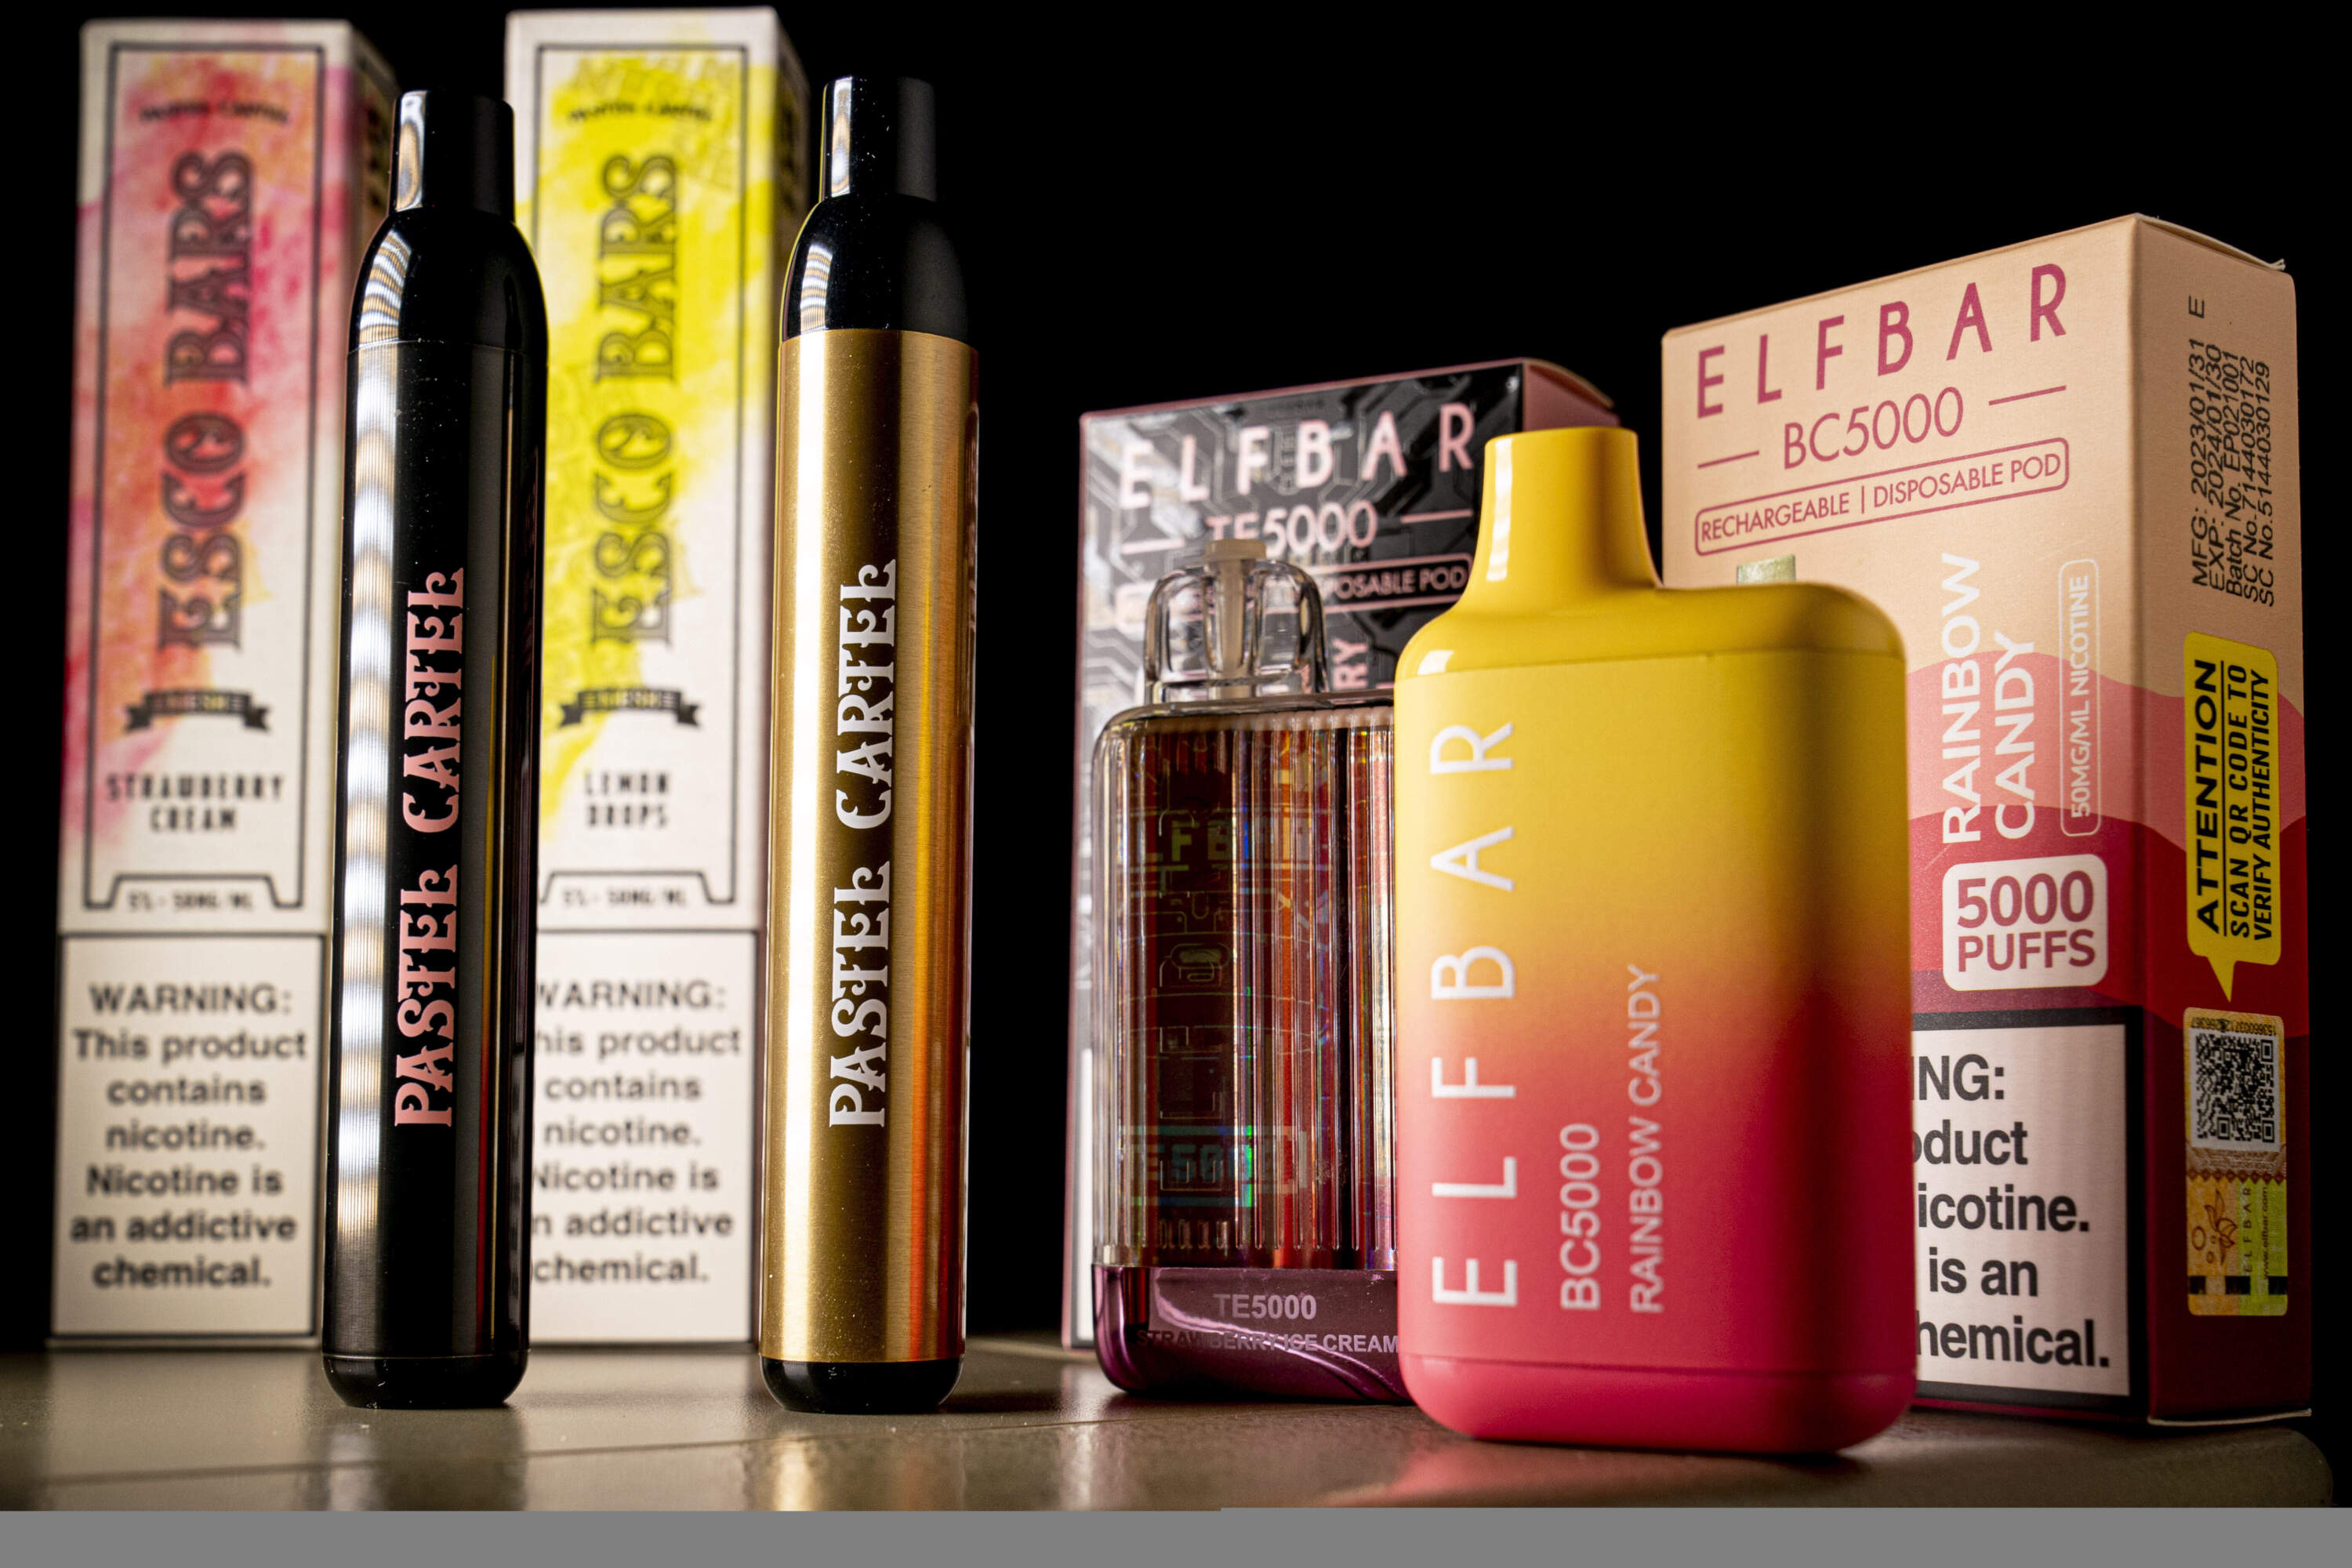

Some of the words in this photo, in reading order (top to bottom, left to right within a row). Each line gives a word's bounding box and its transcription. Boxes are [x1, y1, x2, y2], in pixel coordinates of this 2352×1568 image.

[165, 150, 252, 387] BARS
[594, 152, 680, 386] BARS
[1697, 263, 2067, 419] ELFBAR
[2188, 295, 2205, 318] E
[1783, 387, 1964, 470] BC5000
[2188, 339, 2207, 496] 2023/01/31
[2205, 343, 2224, 510] 2024/01/30
[2222, 350, 2241, 473] EP021001
[1119, 402, 1475, 510] ELFBAR
[1700, 492, 1849, 543] RECHARGEABLE
[1873, 462, 2003, 509] DISPOSABLE
[2010, 452, 2062, 482] POD
[2224, 481, 2241, 521] No.
[2190, 506, 2208, 586] MFG:
[2209, 518, 2225, 591] EXP:
[2225, 528, 2243, 597] Batch
[2244, 564, 2259, 602] SC
[2259, 568, 2274, 607] SC
[2069, 574, 2090, 696] NICOTINE
[403, 566, 465, 833] CARTEL
[836, 559, 897, 829] CARTEL
[1942, 553, 1981, 845] RAINBOW
[2227, 664, 2248, 700] TO
[1994, 630, 2035, 839] CANDY
[2070, 699, 2091, 819] 50MG/ML
[2228, 713, 2248, 792] CODE
[2251, 669, 2270, 850] AUTHENTICITY
[2195, 659, 2220, 935] ATTENTION
[2229, 803, 2252, 845] QR
[1957, 870, 2096, 930] 5000
[2230, 858, 2250, 939] SCAN
[2253, 853, 2272, 941] VERIFY
[1958, 928, 2096, 973] PUFFS
[89, 984, 292, 1015] WARNING:
[394, 863, 458, 1127] PASTEL
[829, 861, 891, 1128] PASTEL
[1430, 721, 1518, 1307] ELFBAR
[73, 1029, 150, 1062] This
[162, 1030, 308, 1064] product
[535, 1024, 584, 1054] his
[598, 1028, 742, 1059] product
[1628, 964, 1661, 1107] CANDY
[106, 1076, 267, 1107] contains
[544, 1073, 703, 1101] contains
[106, 1119, 265, 1151] nicotine.
[544, 1118, 702, 1148] nicotine.
[85, 1165, 240, 1197] Nicotine
[252, 1166, 284, 1196] is
[689, 1163, 720, 1191] is
[1918, 1181, 2090, 1233] icotine.
[70, 1218, 117, 1243] an
[126, 1210, 298, 1243] addictive
[532, 1214, 551, 1236] n
[565, 1207, 734, 1237] addictive
[1560, 1123, 1600, 1311] BC5000
[1629, 1116, 1664, 1314] RAINBOW
[93, 1256, 272, 1289] chemical.
[532, 1253, 711, 1283] chemical.
[1928, 1247, 1968, 1294] is
[1980, 1259, 2039, 1298] an
[1214, 1294, 1318, 1320] TE5000
[1283, 1333, 1319, 1352] ICE
[1323, 1333, 1399, 1353] CREAM
[1915, 1310, 2111, 1369] hemical.
